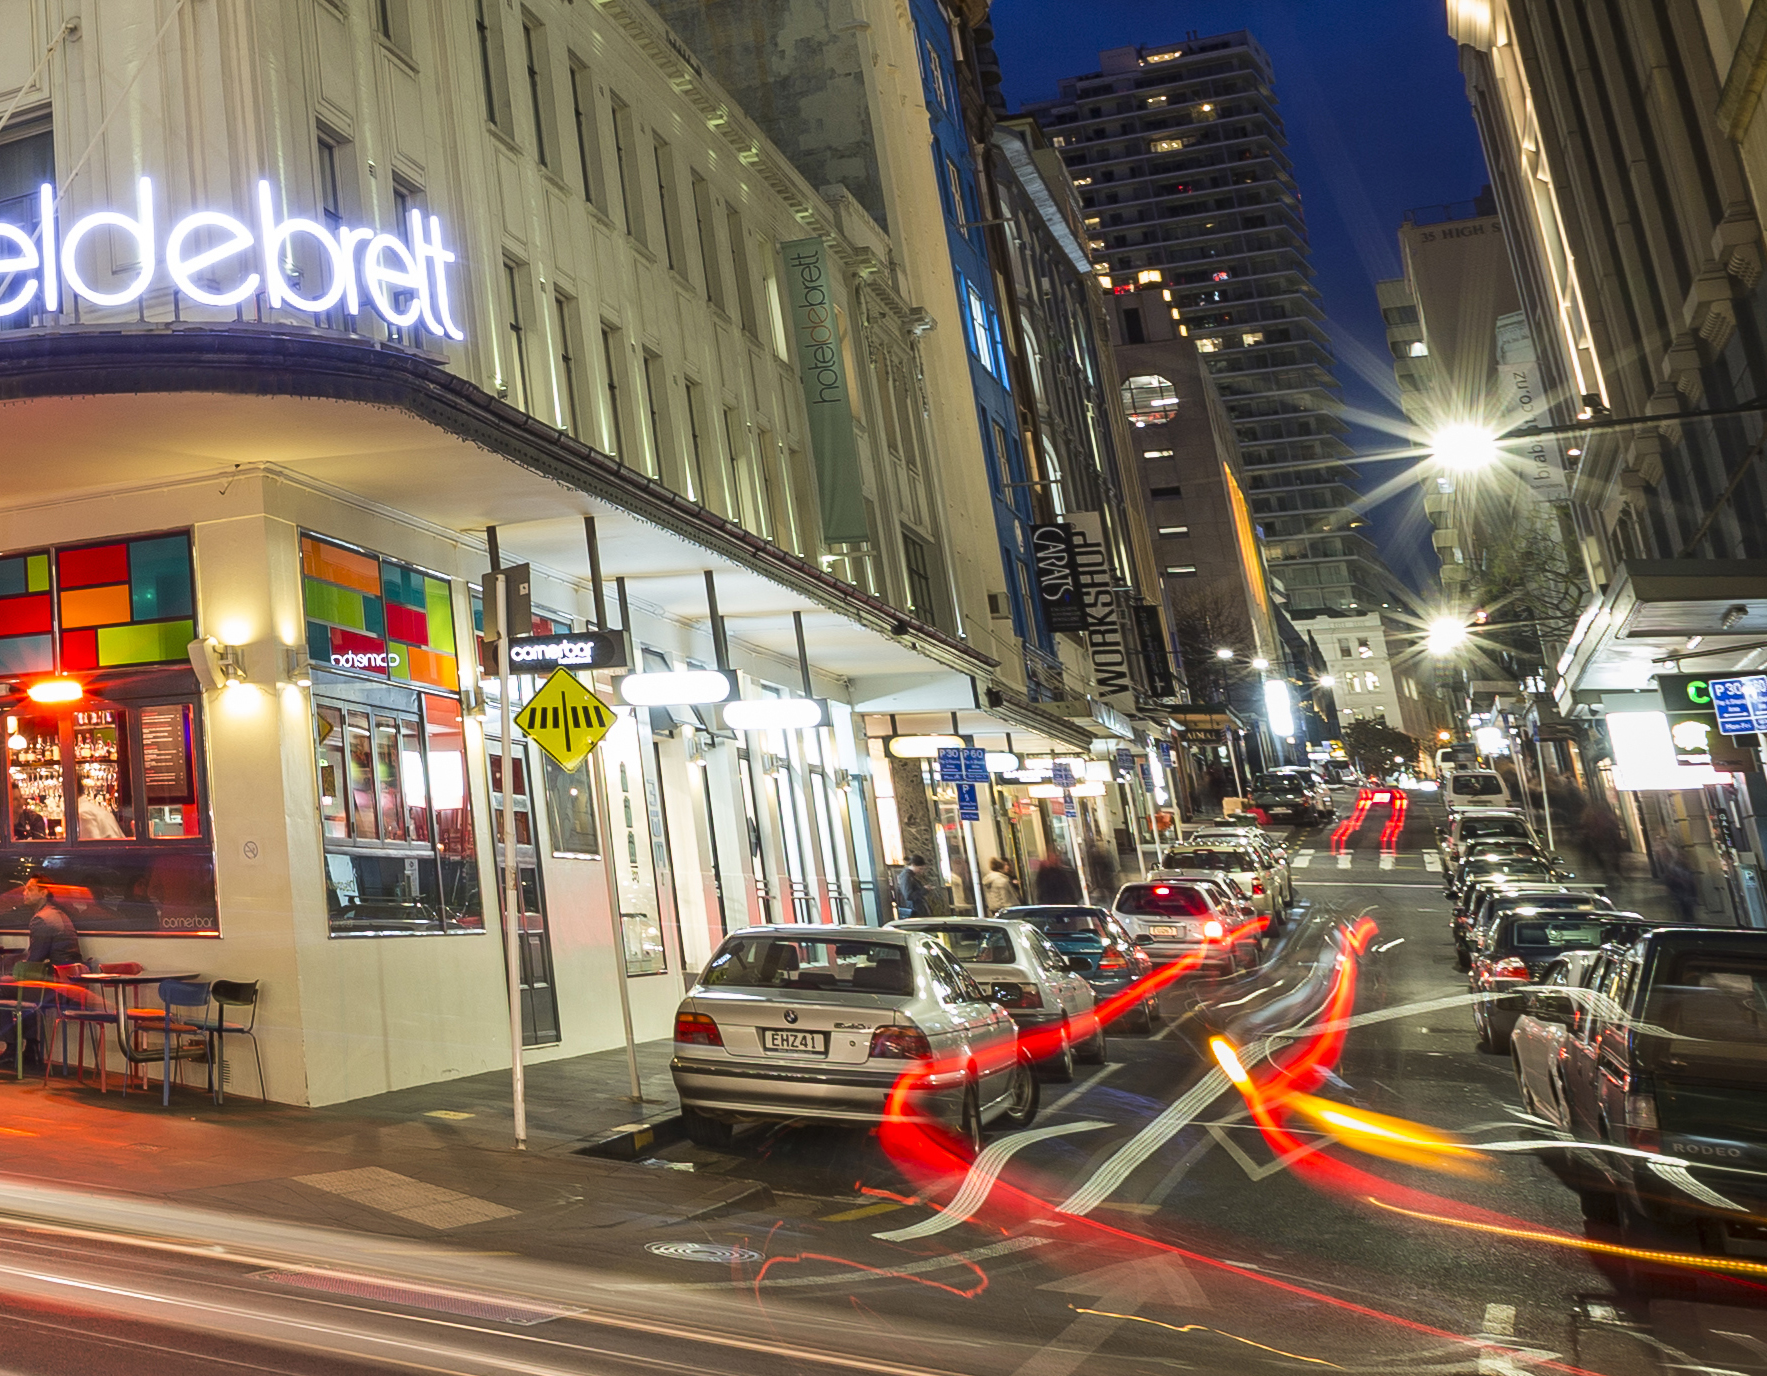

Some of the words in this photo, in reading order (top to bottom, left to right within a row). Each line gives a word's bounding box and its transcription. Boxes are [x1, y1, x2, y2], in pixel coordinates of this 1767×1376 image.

[1421, 232, 1437, 243] 35
[1442, 224, 1485, 240] HIGH
[790, 249, 842, 405] hoteldebrett
[1033, 526, 1074, 600] CARATS
[1072, 530, 1131, 698] WORKSHOP
[510, 639, 594, 662] cornerbar
[162, 914, 214, 928] cornerbar
[771, 1032, 816, 1049] EHZ41
[1673, 1143, 1741, 1157] RODEO
